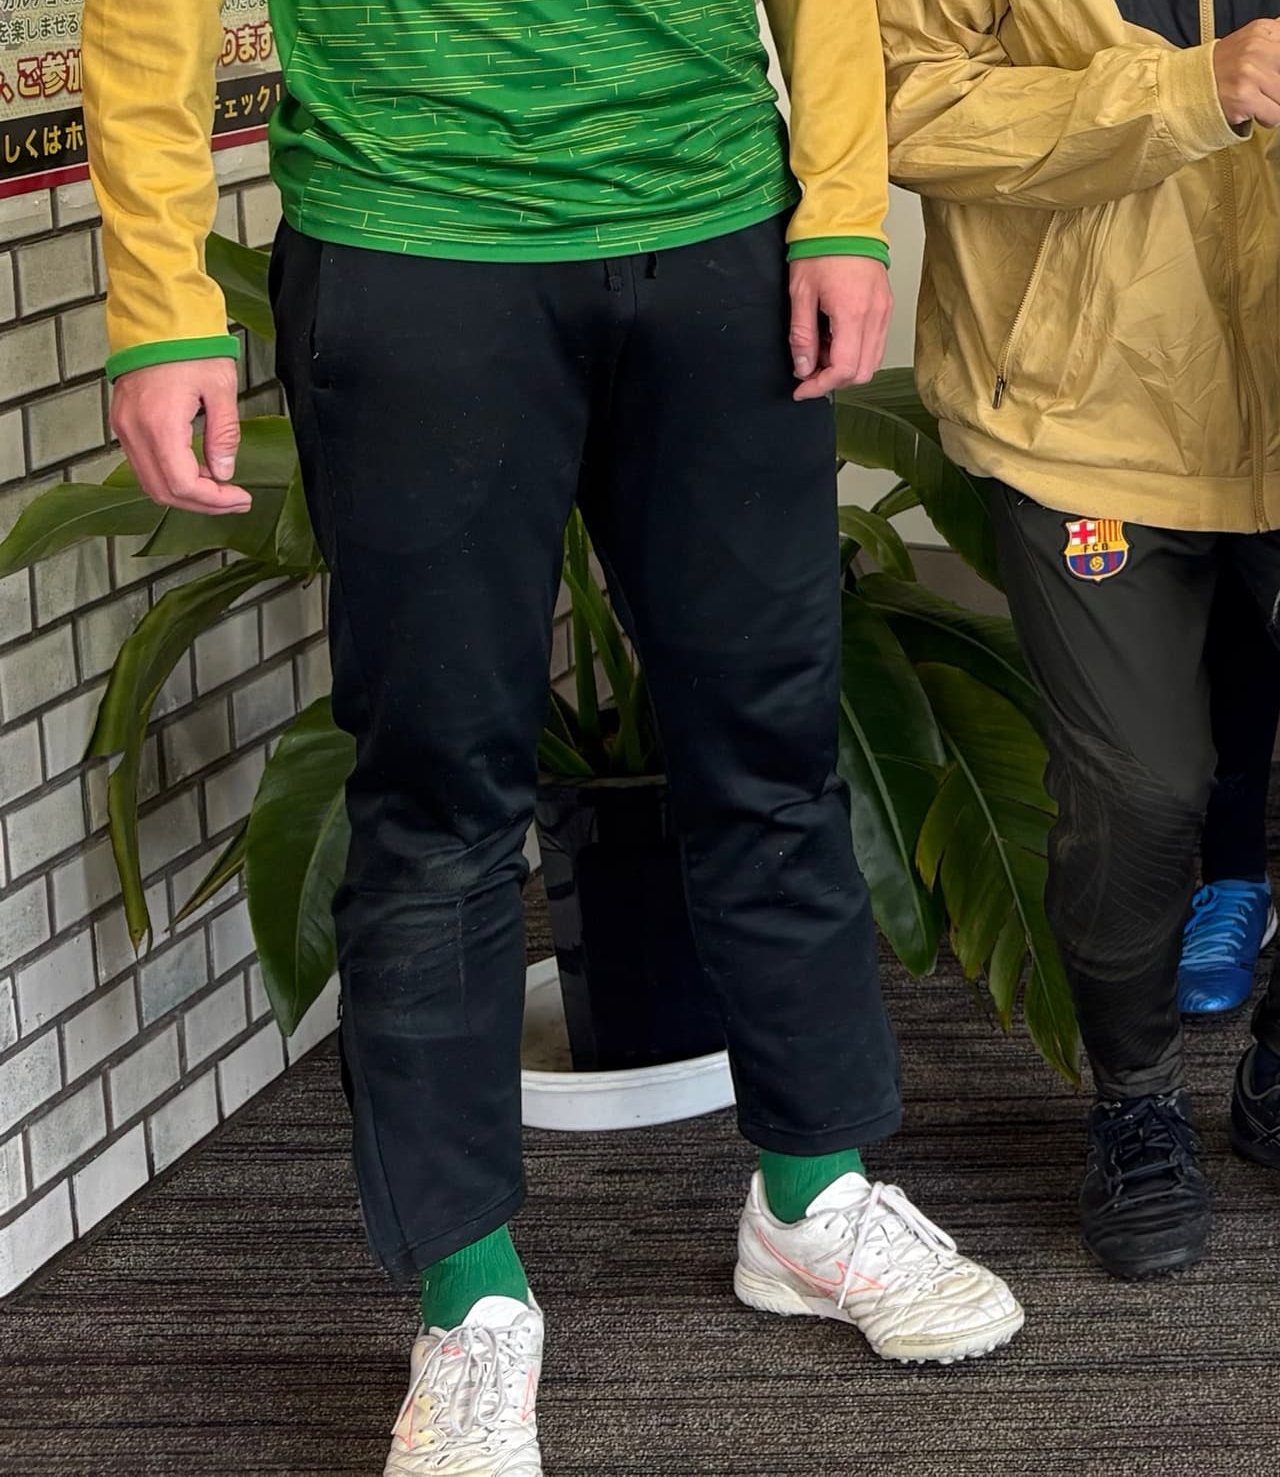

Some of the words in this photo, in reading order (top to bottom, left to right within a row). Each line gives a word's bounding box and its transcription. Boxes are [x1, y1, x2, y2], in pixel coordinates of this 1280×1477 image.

[4, 121, 84, 164] しくはホ
[1083, 542, 1109, 553] FCB
